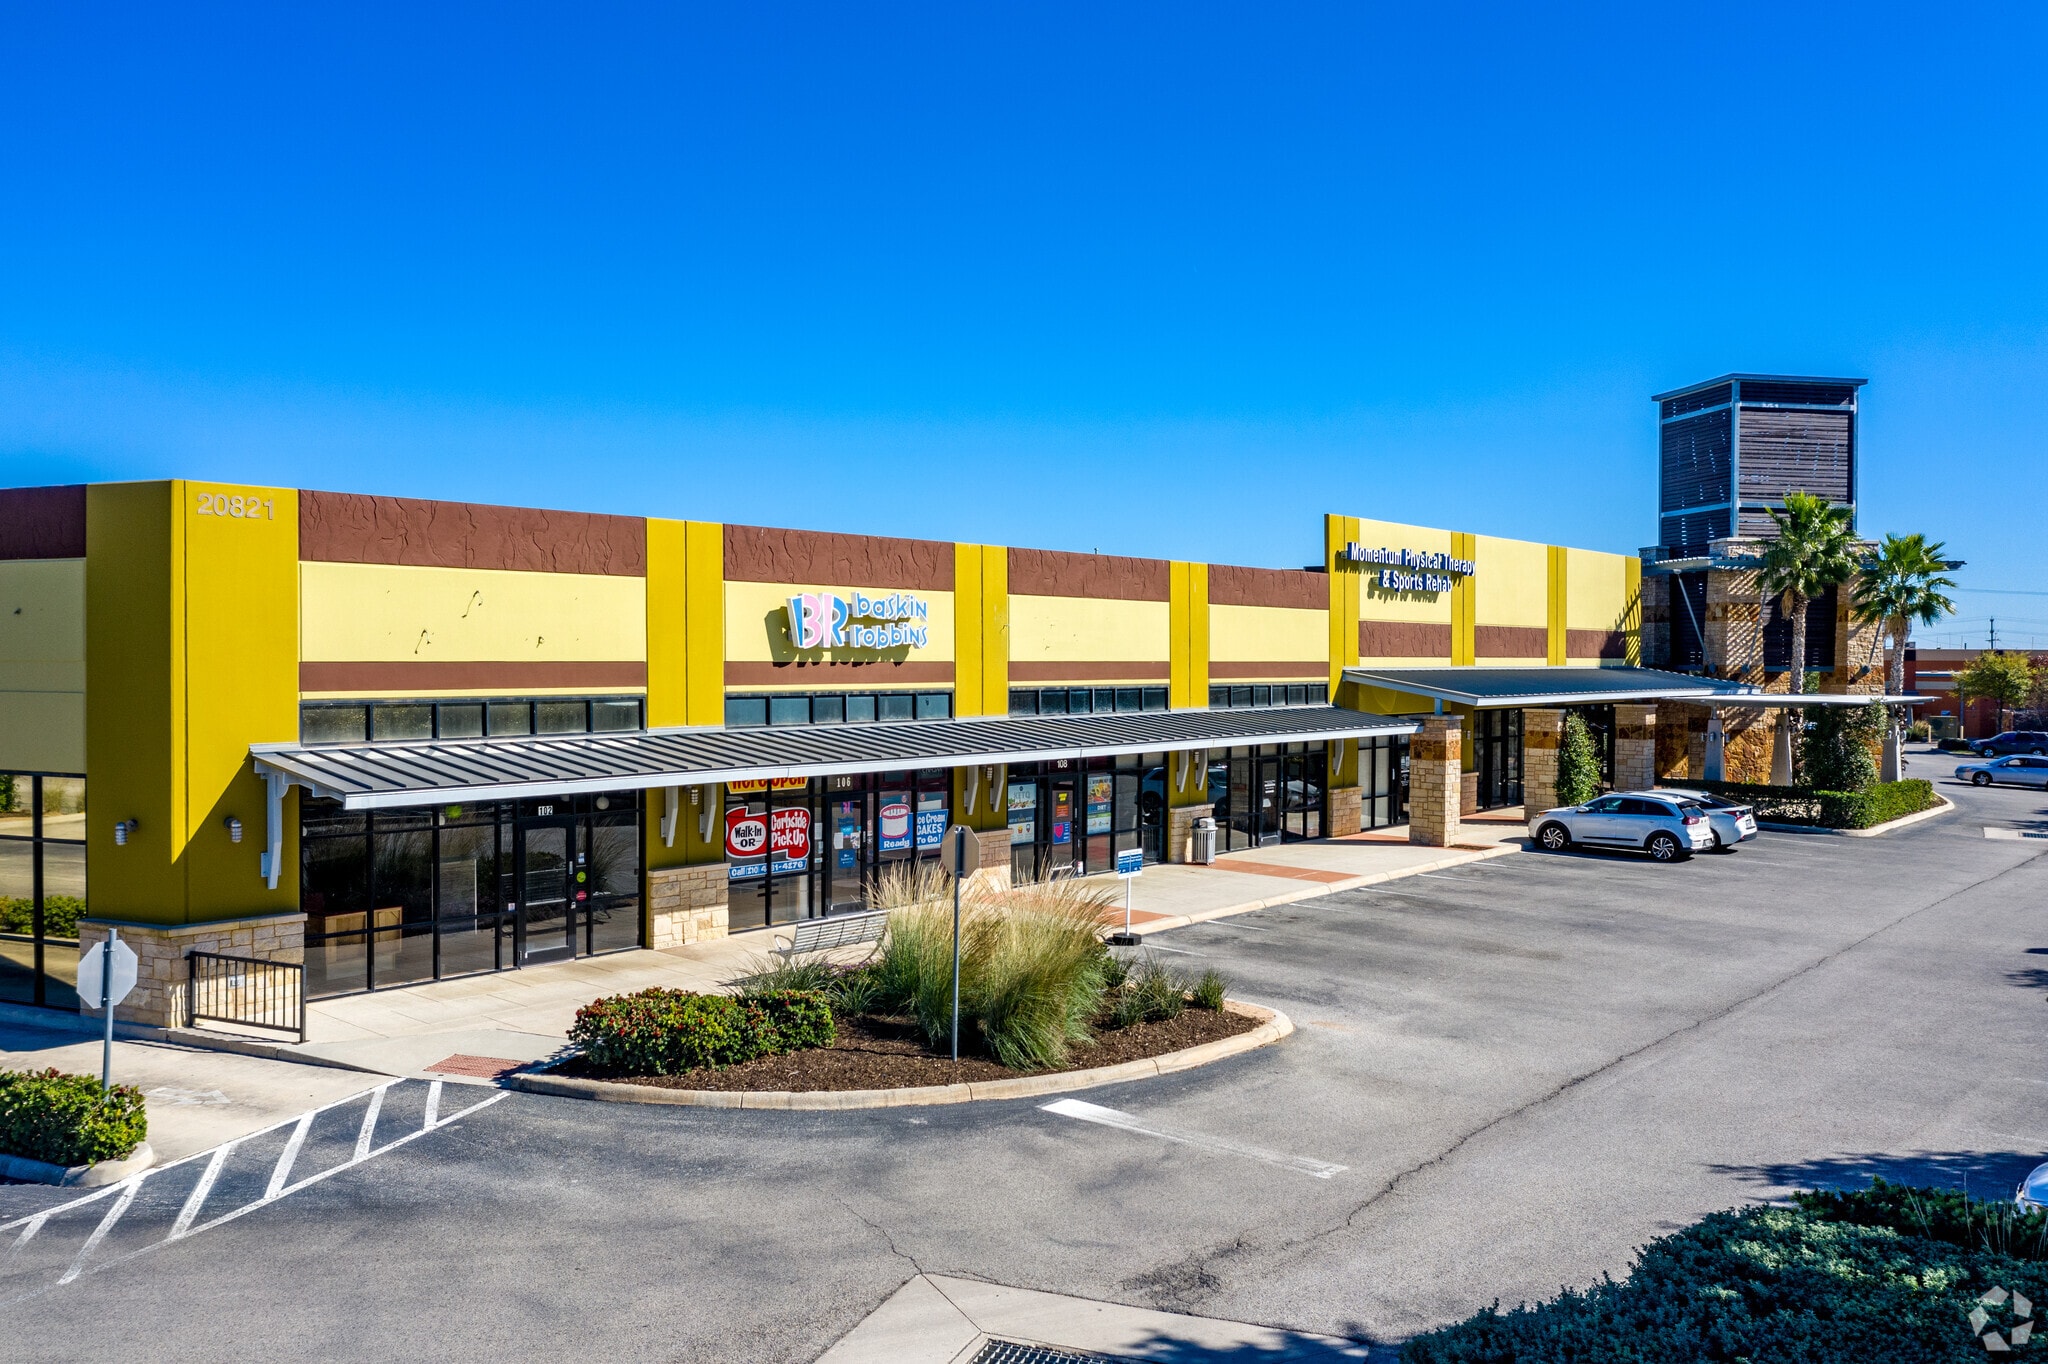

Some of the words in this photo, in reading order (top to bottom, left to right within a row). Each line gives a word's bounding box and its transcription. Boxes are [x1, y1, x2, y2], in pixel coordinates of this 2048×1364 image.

[197, 493, 274, 521] 20821
[1348, 542, 1402, 565] Momentum
[1405, 549, 1441, 571] Physical
[1444, 554, 1476, 576] Therapy
[1382, 570, 1390, 588] &
[1393, 571, 1423, 592] Sports
[1426, 574, 1452, 592] Rehab
[855, 592, 928, 620] baskin
[790, 593, 848, 649] BR
[854, 623, 928, 649] robbins
[1057, 760, 1068, 768] 108
[837, 777, 851, 788] 106
[538, 806, 553, 816] 102
[771, 811, 807, 831] Curbside
[926, 813, 945, 824] Cream
[735, 825, 762, 838] Walk-In
[917, 823, 942, 836] CAKES
[884, 838, 910, 849] Ready
[731, 867, 745, 877] Call
